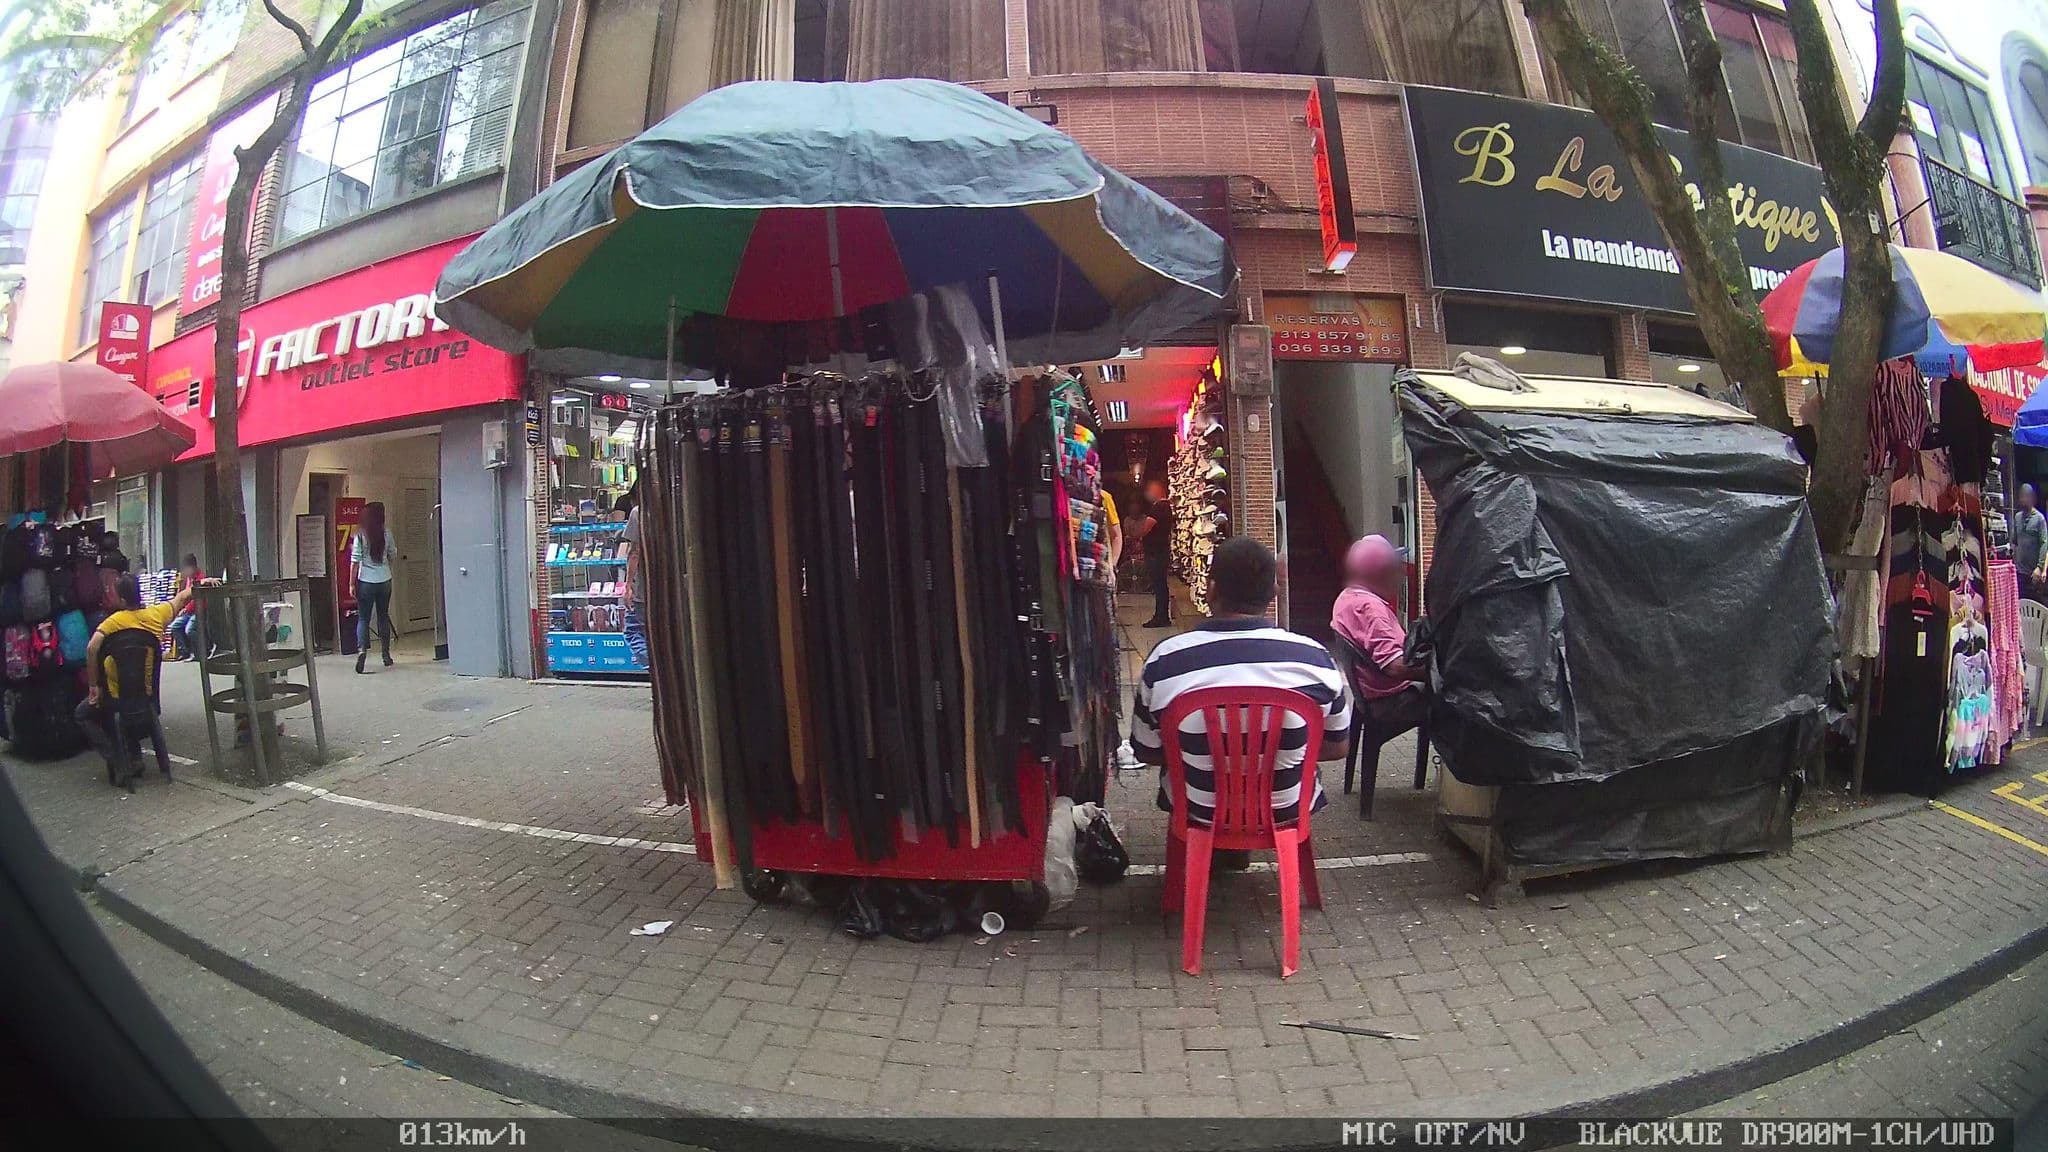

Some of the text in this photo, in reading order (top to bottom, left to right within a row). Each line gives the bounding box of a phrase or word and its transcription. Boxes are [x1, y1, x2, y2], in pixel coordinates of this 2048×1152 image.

[1454, 122, 1516, 186] B
[1535, 136, 1623, 202] La
[1541, 229, 1570, 259] La
[1572, 237, 1681, 275] mandamá
[1274, 313, 1360, 326] RESERVAS
[1280, 330, 1311, 339] 313
[1317, 331, 1350, 340] 857
[1279, 343, 1402, 355] 036 333 8693
[301, 340, 470, 391] outlet store
[2014, 368, 2027, 401] DE
[561, 639, 583, 647] TECNO
[603, 639, 625, 648] TECNO
